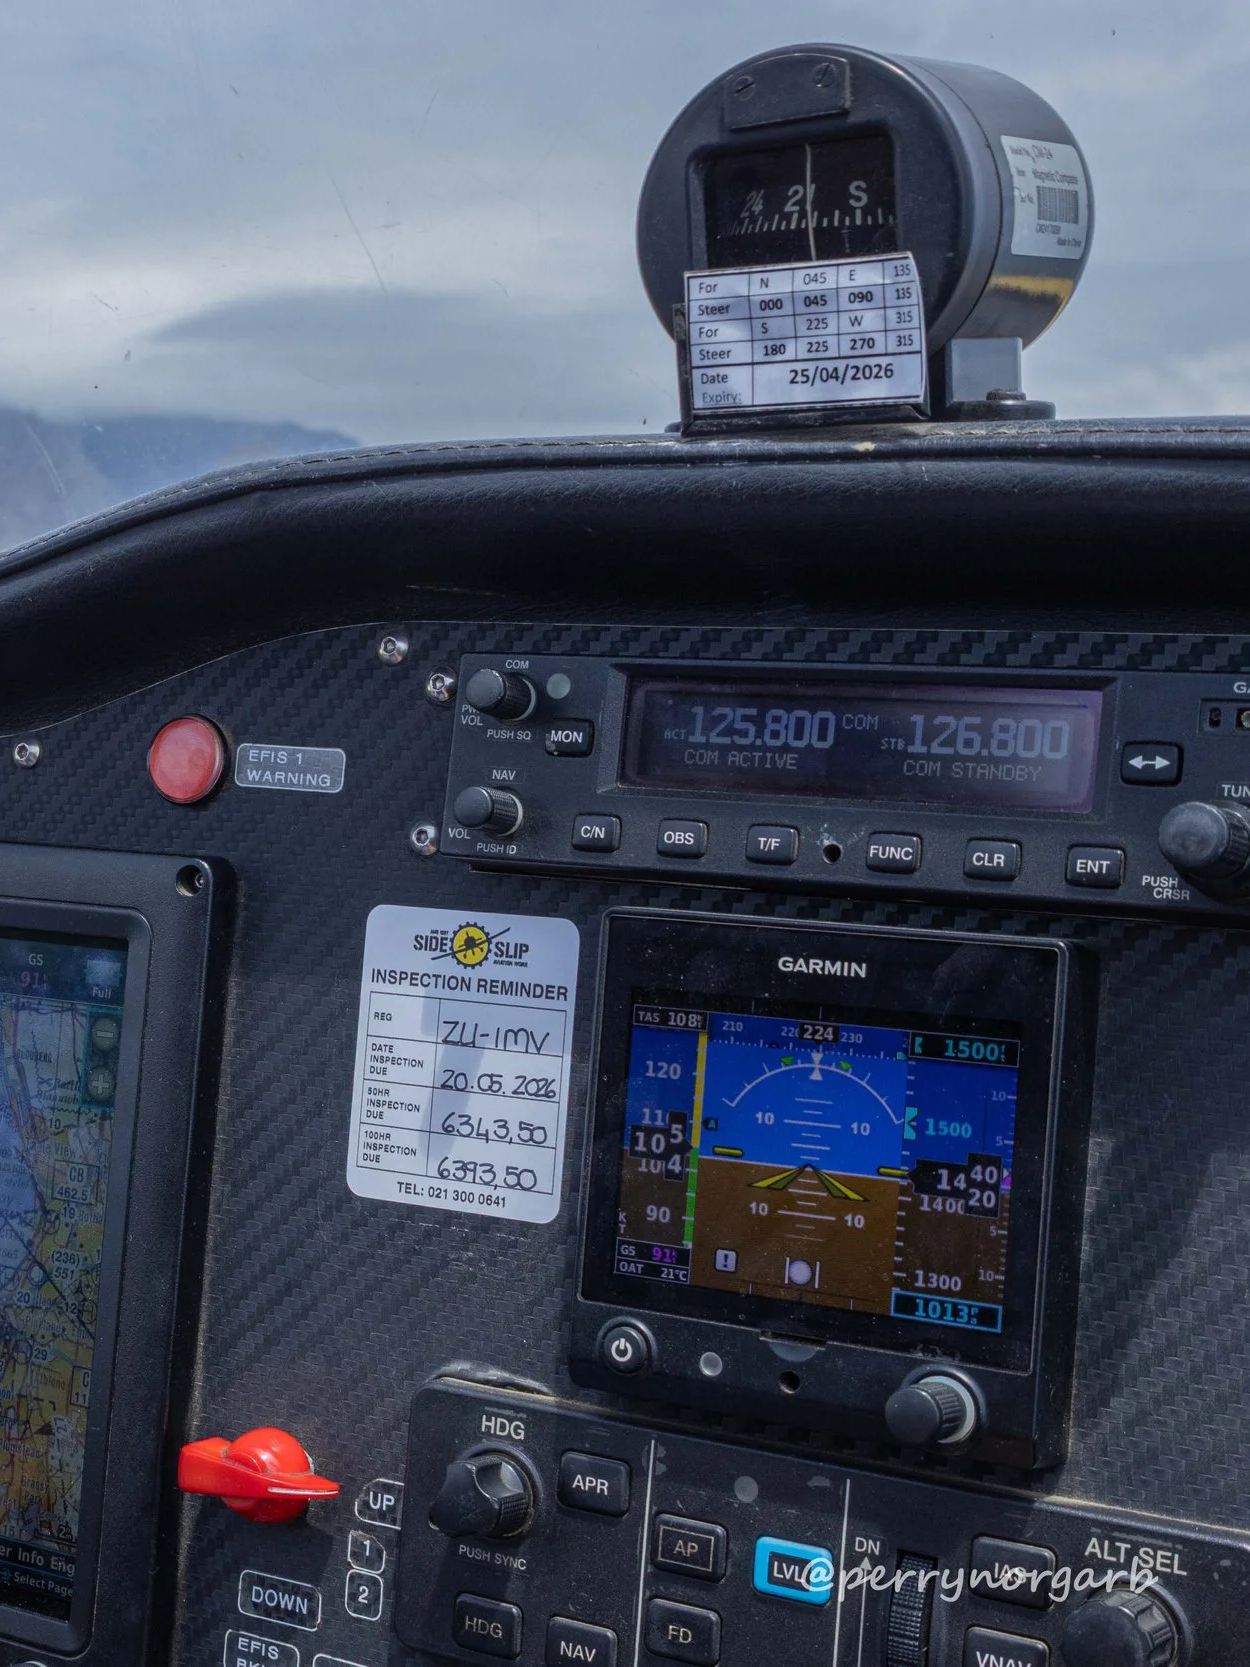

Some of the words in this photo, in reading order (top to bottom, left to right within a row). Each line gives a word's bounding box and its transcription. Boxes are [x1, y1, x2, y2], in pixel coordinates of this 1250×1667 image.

[698, 282, 718, 293] For
[760, 278, 769, 288] N
[803, 273, 827, 285] 045
[849, 270, 856, 281] E
[894, 264, 911, 277] 135
[698, 304, 730, 315] Steer
[760, 299, 783, 311] 000
[804, 295, 827, 307] 045
[848, 291, 873, 303] 090
[895, 288, 911, 299] 135
[699, 327, 719, 338] For
[761, 323, 768, 334] S
[806, 318, 828, 330] 225
[849, 315, 863, 327] W
[895, 311, 912, 323] 315
[699, 349, 731, 361] Steer
[763, 344, 786, 356] 180
[807, 341, 828, 353] 225
[850, 338, 875, 350] 270
[896, 335, 913, 347] 315
[701, 373, 728, 384] Date
[789, 363, 894, 387] 25/04/2026
[702, 393, 742, 404] Expiry:
[505, 659, 529, 669] COM
[462, 715, 483, 726] VOL
[688, 706, 835, 748] 125.800
[842, 714, 878, 730] COM
[487, 729, 513, 740] PUSH
[515, 730, 532, 741] SQ
[550, 730, 582, 743] MON
[907, 714, 1069, 759] 126.800
[249, 749, 287, 764] EFIS
[296, 751, 303, 765] 1
[684, 749, 718, 765] COM
[728, 752, 798, 769] ACTIVE
[247, 768, 332, 788] WARNING
[492, 769, 515, 780] NAV
[903, 761, 940, 776] COM
[952, 765, 1042, 782] STANDBY
[448, 828, 471, 839] VOL
[581, 825, 605, 839] C/N
[664, 831, 694, 846] OBS
[477, 843, 503, 853] PUSH
[507, 844, 517, 855] ID
[758, 837, 781, 851] T/F
[870, 845, 913, 861] FUNC
[972, 853, 1004, 868] CLR
[1076, 860, 1110, 874] ENT
[1142, 876, 1178, 888] PUSH
[1153, 888, 1190, 900] CRSR
[413, 934, 448, 952] SIDE
[494, 942, 529, 960] SLIP
[28, 953, 44, 966] GS
[778, 956, 867, 979] GARMIN
[371, 968, 471, 992] INSPECTION
[477, 979, 568, 1001] REMINDER
[92, 987, 112, 999] Full
[374, 1012, 392, 1022] REG
[638, 1012, 660, 1023] TAS
[723, 1021, 744, 1032] 210
[803, 1024, 834, 1041] 224
[841, 1032, 863, 1044] 230
[371, 1044, 393, 1054] DATE
[370, 1055, 424, 1068] INSPECTION
[370, 1066, 387, 1076] DUE
[646, 1061, 681, 1079] 120
[367, 1087, 390, 1097] 50HR
[366, 1099, 420, 1112] INSPECTION
[366, 1110, 384, 1119] DUE
[756, 1112, 774, 1124] 10
[364, 1131, 391, 1141] 100HR
[851, 1122, 870, 1135] 10
[925, 1118, 972, 1138] 1500
[363, 1142, 417, 1156] INSPECTION
[362, 1153, 381, 1163] DUE
[69, 1167, 84, 1183] CB
[57, 1185, 88, 1200] 462.5
[398, 1181, 424, 1196] TEL:
[428, 1186, 448, 1200] 021
[453, 1190, 474, 1203] 300
[478, 1194, 506, 1208] 0641
[646, 1205, 670, 1223] 90
[51, 1250, 81, 1266] (236)
[621, 1245, 636, 1257] GS
[619, 1262, 643, 1274] OAT
[914, 1271, 961, 1291] 1300
[481, 1415, 525, 1440] HDG
[572, 1474, 608, 1495] APR
[369, 1492, 394, 1510] UP
[364, 1540, 371, 1555] 1
[673, 1540, 698, 1557] AP
[855, 1538, 880, 1555] DN
[18, 1548, 45, 1566] Info
[50, 1557, 76, 1576] Eng
[459, 1545, 490, 1562] PUSH
[494, 1553, 527, 1570] SYNC
[1084, 1537, 1130, 1563] ALT
[1139, 1549, 1187, 1576] SEL
[14, 1571, 46, 1590] Select
[48, 1581, 74, 1598] Page
[252, 1586, 307, 1614] DOWN
[358, 1586, 368, 1604] 2
[465, 1617, 502, 1638] HDG
[668, 1625, 691, 1643] FD
[238, 1638, 279, 1659] EFIS
[560, 1641, 596, 1662] NAV
